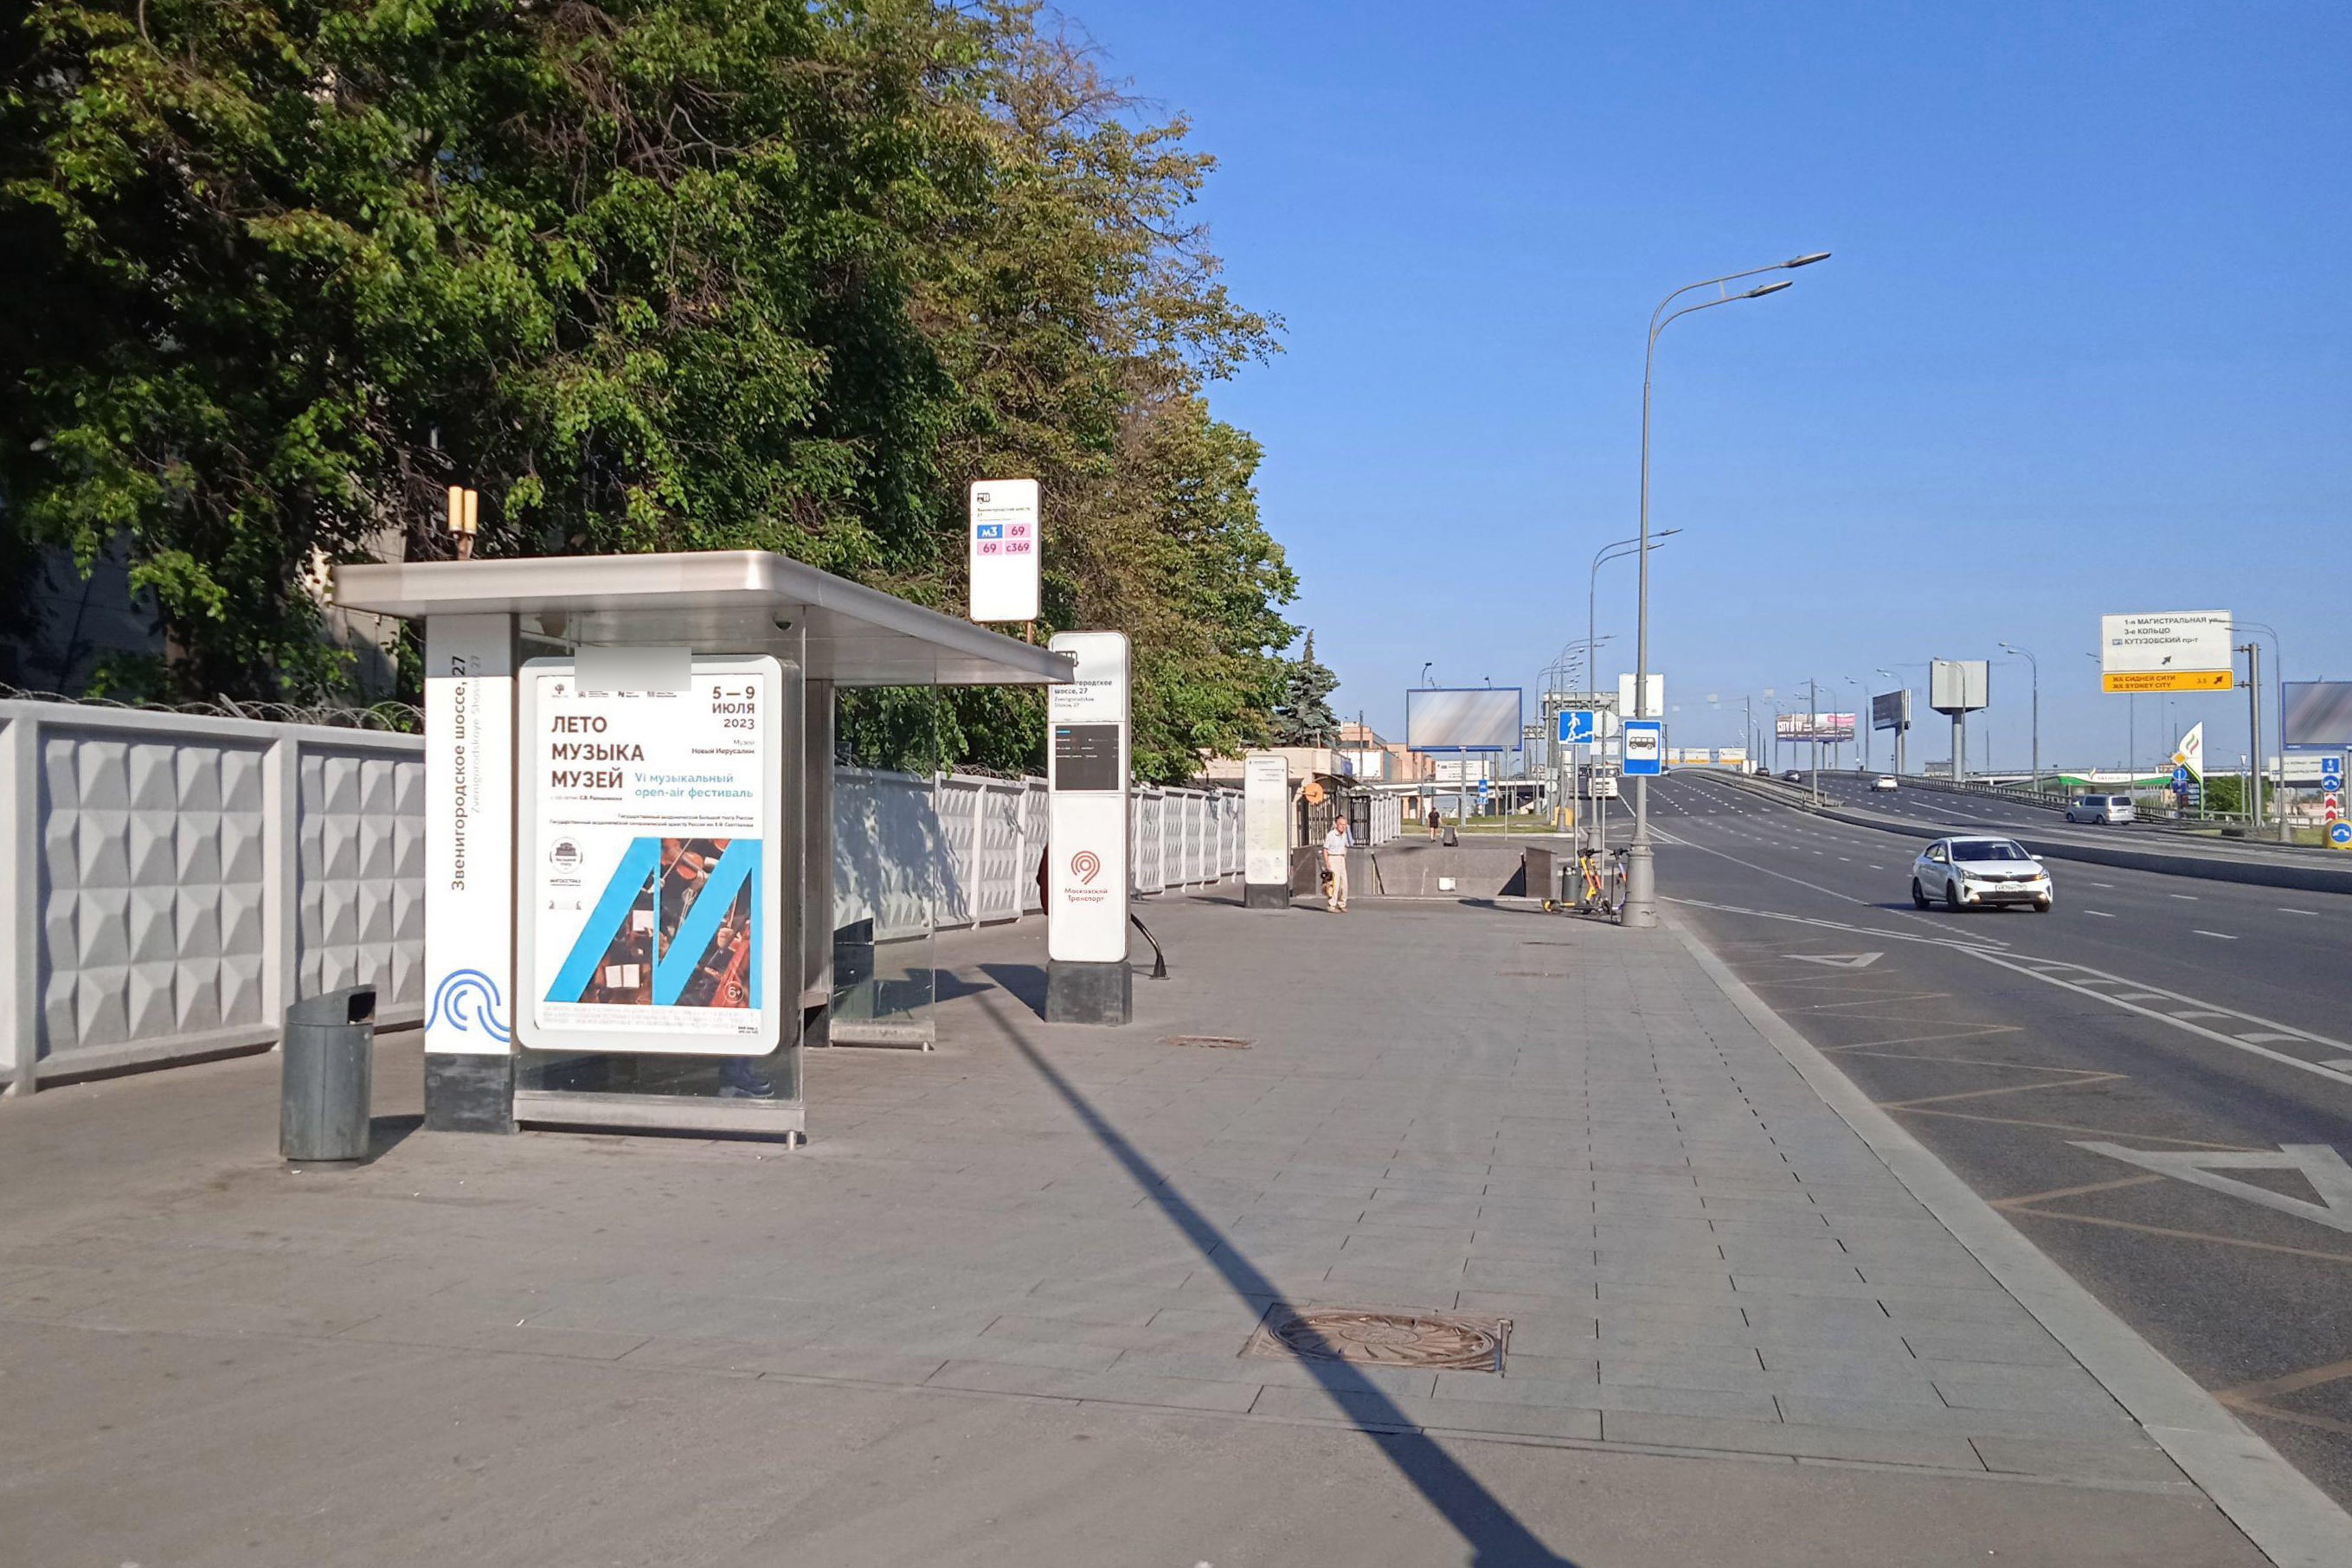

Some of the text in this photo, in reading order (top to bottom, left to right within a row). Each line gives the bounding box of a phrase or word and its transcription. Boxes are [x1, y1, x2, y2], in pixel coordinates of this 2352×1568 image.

[1012, 526, 1025, 536] 69
[983, 543, 997, 553] 69
[712, 685, 722, 699] 5
[745, 685, 755, 699] 9
[712, 703, 755, 714] ИЮЛЯ
[551, 716, 607, 733] ЛЕТО
[723, 718, 755, 729] 2023
[551, 742, 645, 761] МУЗЫКА
[451, 655, 468, 890] Звенигородское шоссе, 27
[551, 767, 623, 788] МУЗЕЙ
[650, 773, 734, 785] музыкальный
[634, 787, 754, 800] open-air фестиваль
[729, 986, 741, 998] 6+
